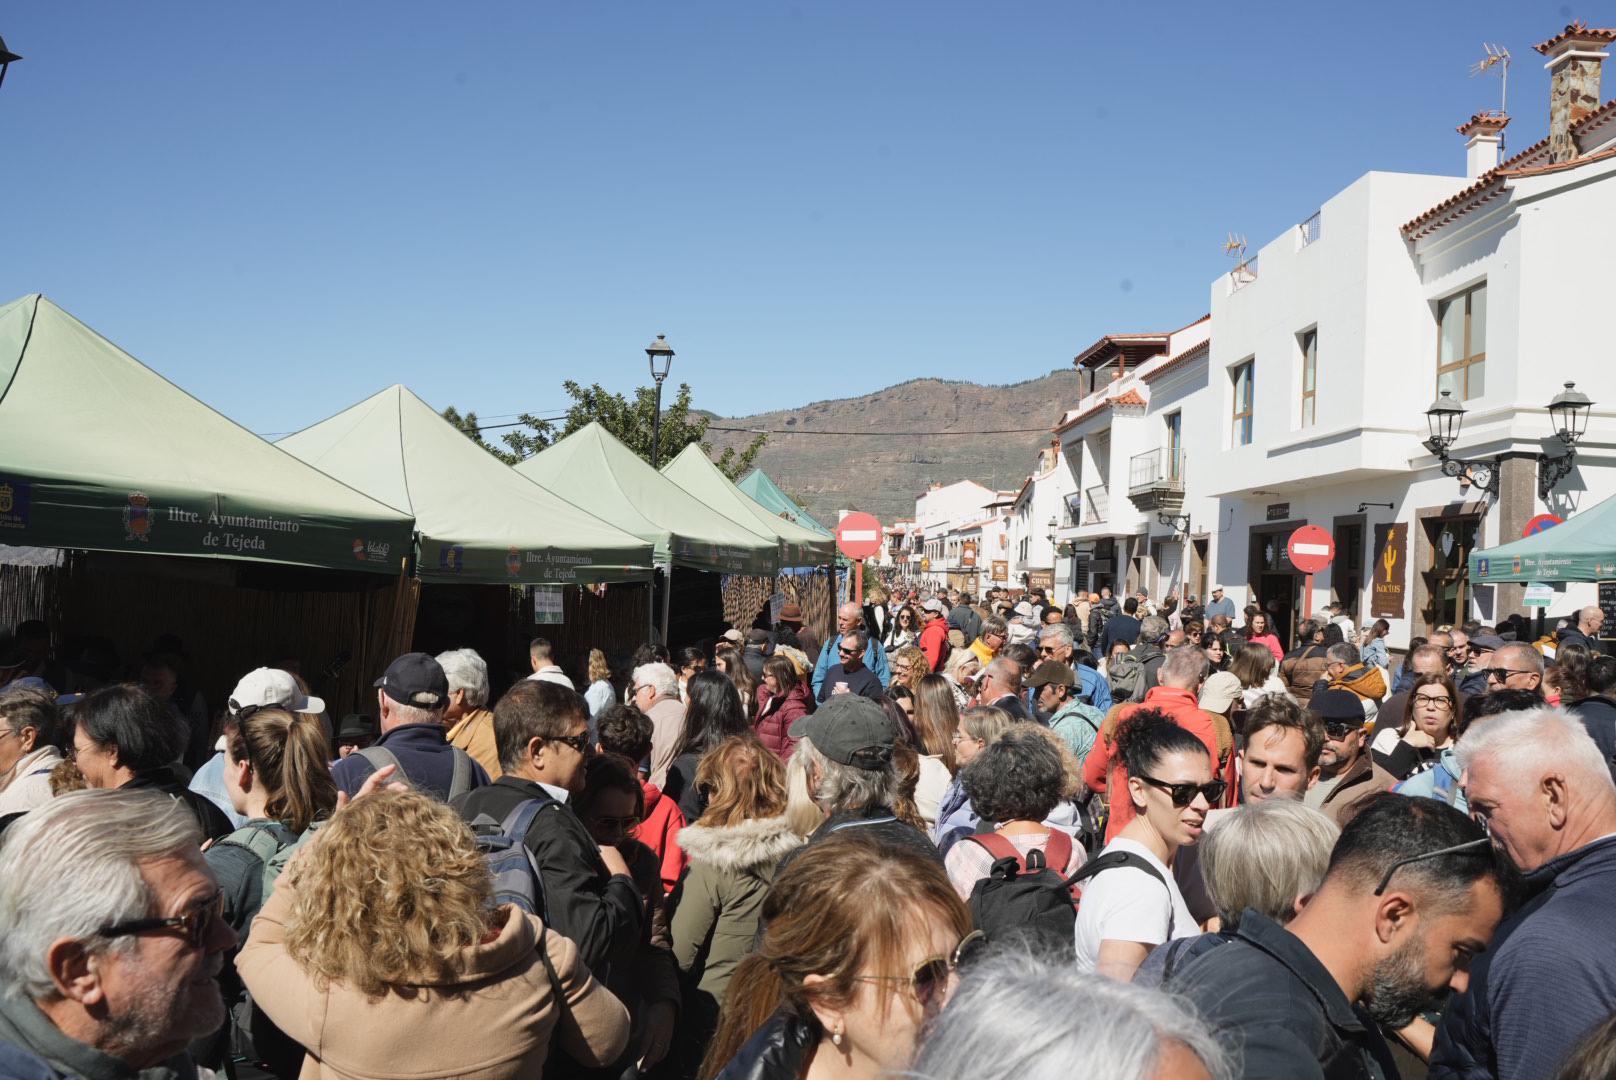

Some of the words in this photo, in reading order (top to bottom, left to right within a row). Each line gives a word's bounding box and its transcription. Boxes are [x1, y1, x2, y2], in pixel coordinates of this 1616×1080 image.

[168, 506, 202, 524] Iltre.
[208, 511, 300, 533] Ayuntamiento
[203, 531, 219, 547] de
[223, 533, 265, 551] Tejeda
[546, 553, 592, 566] Ayuntamiento
[1538, 559, 1571, 567] Ayuntamiento
[544, 567, 553, 579] de
[555, 567, 577, 581] Tejeda
[1543, 568, 1558, 577] Tejeda
